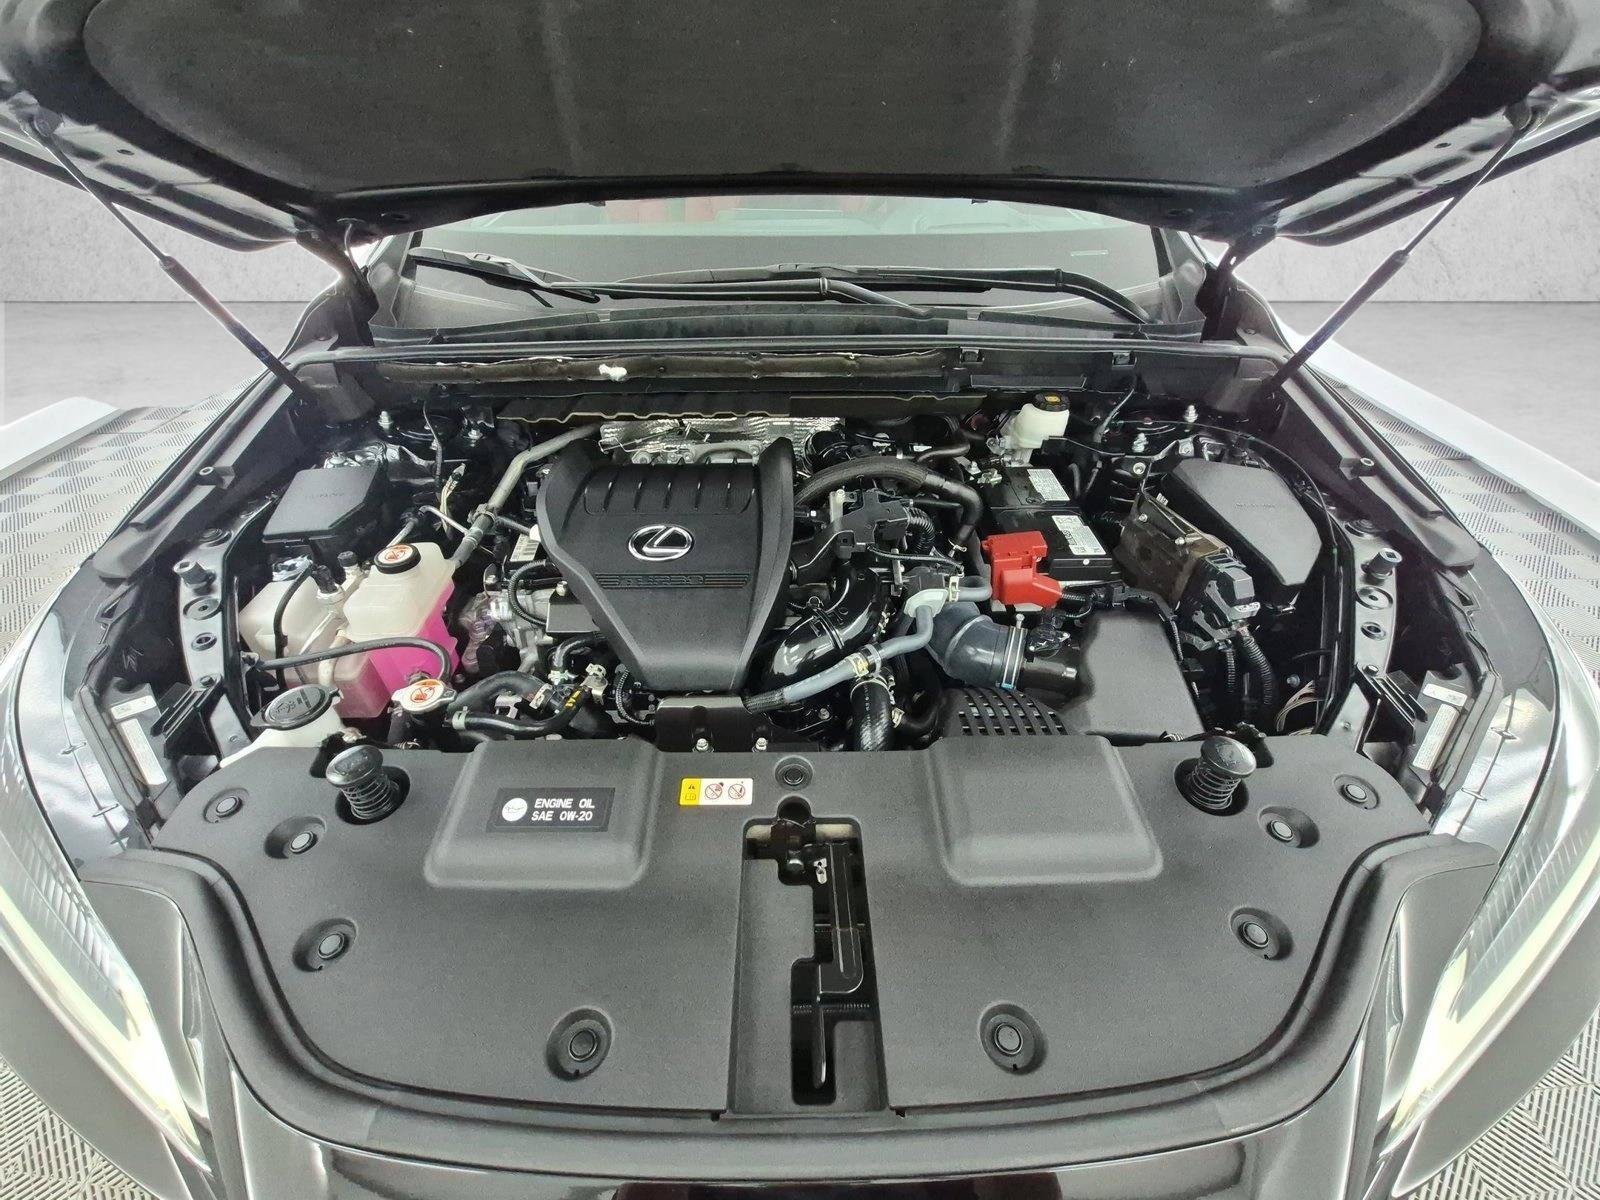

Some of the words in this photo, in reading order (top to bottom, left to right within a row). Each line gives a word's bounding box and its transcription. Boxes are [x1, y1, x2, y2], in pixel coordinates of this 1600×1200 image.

[534, 798, 574, 808] ENGINE
[578, 798, 595, 808] OIL
[531, 811, 554, 821] SAE
[559, 811, 593, 821] 0W-20
